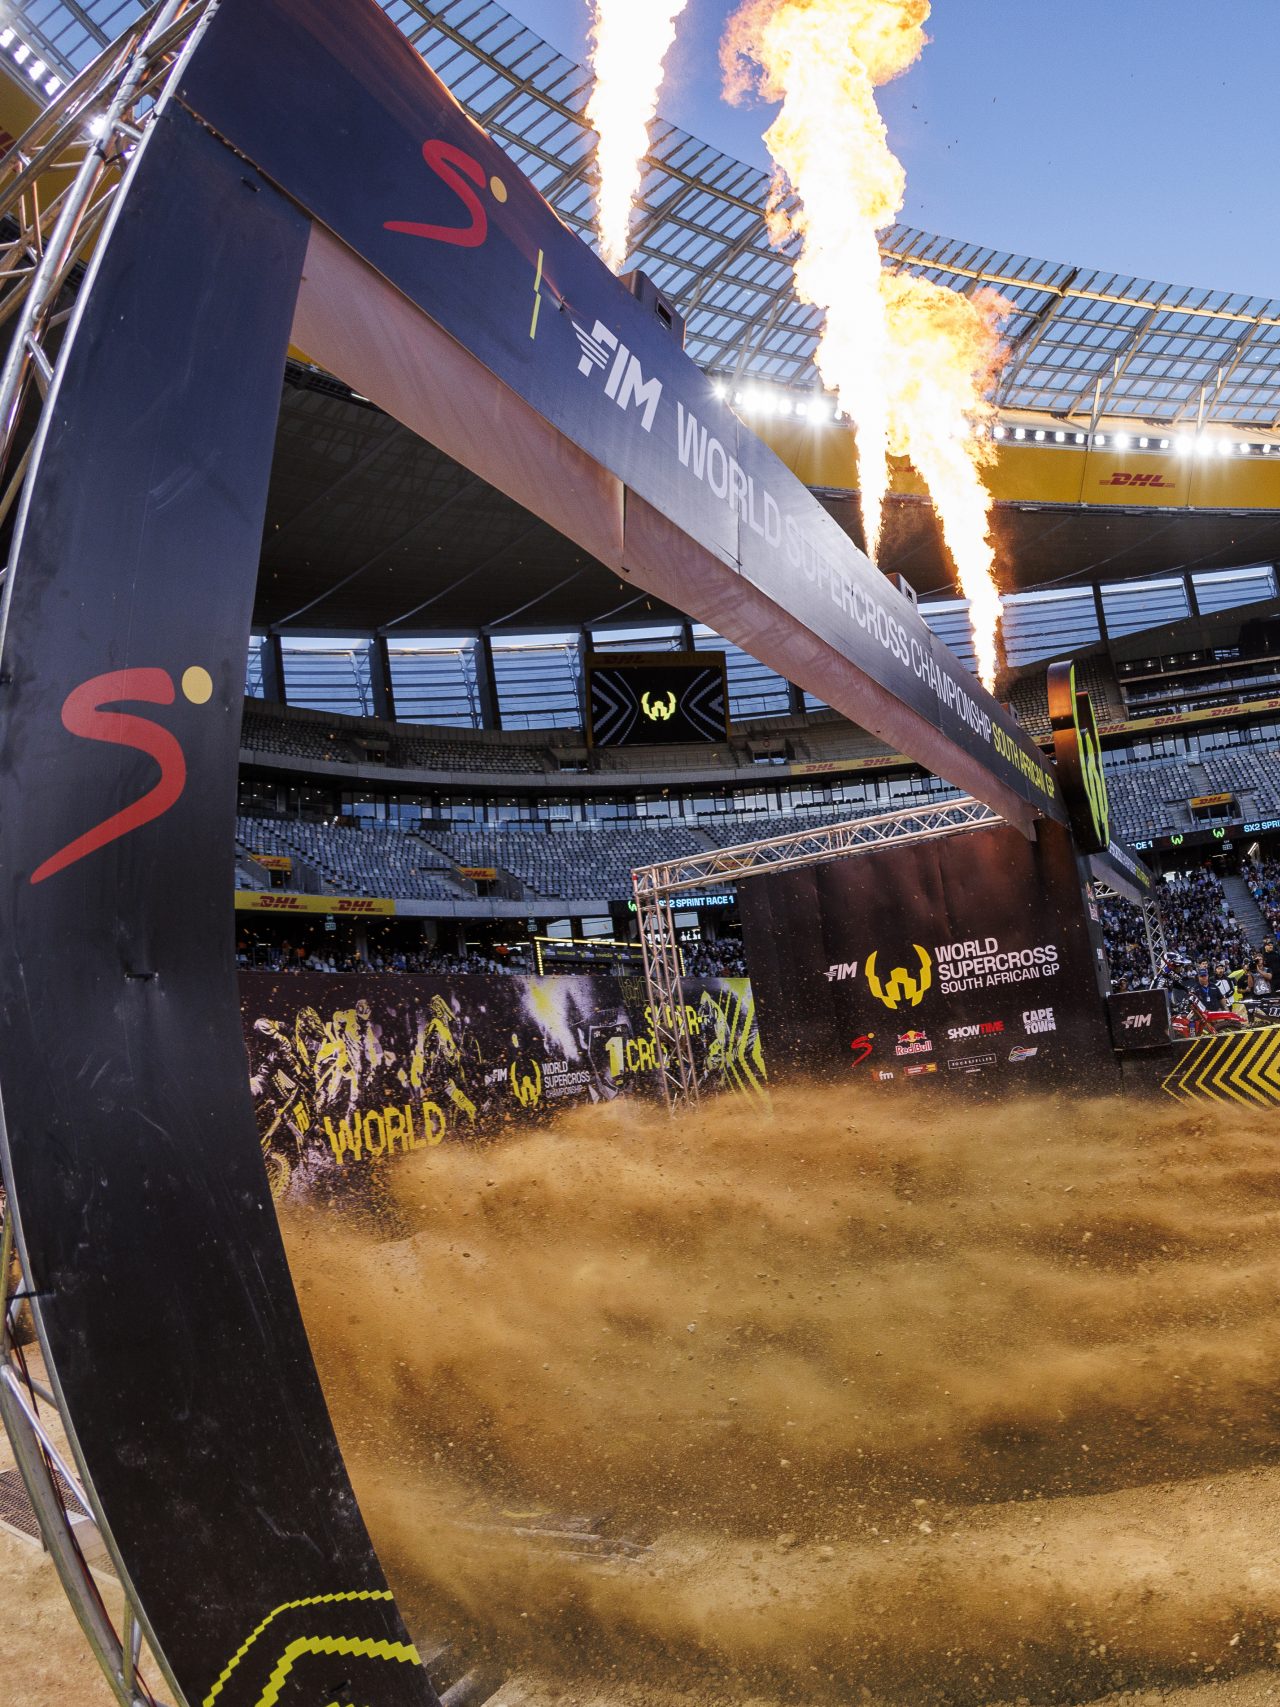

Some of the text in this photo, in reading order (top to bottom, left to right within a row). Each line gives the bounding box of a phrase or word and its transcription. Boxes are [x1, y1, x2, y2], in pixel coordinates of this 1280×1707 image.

[1111, 472, 1166, 488] DHL
[571, 319, 663, 433] FIM
[677, 401, 781, 548] WORLD
[785, 514, 910, 667] SUPERCROSS
[910, 637, 993, 744] CHAMPIONSHIP
[992, 721, 1020, 771] SOUTH
[1211, 706, 1241, 716] DHL
[1154, 715, 1183, 725] DHL
[1099, 724, 1127, 733] DHL
[805, 762, 834, 772] DHL
[862, 757, 894, 766] DHL
[1244, 823, 1261, 833] SX2
[260, 896, 300, 910] DHL
[338, 900, 376, 912] DHL
[676, 898, 705, 908] SPRINT
[706, 896, 728, 906] RACE
[934, 937, 998, 964] WORLD
[938, 944, 1058, 981] SUPERCROSS
[822, 962, 858, 982] FIM
[940, 962, 1060, 994] SOUTH AFRICAN GP
[1022, 1007, 1054, 1024] CAPE
[1121, 1013, 1152, 1028] FIM
[1024, 1021, 1056, 1034] TOWN
[896, 1040, 932, 1056] Red Bull
[542, 1060, 568, 1075] WORLD
[544, 1071, 590, 1088] SUPERCROSS
[324, 1101, 446, 1164] WORLD
